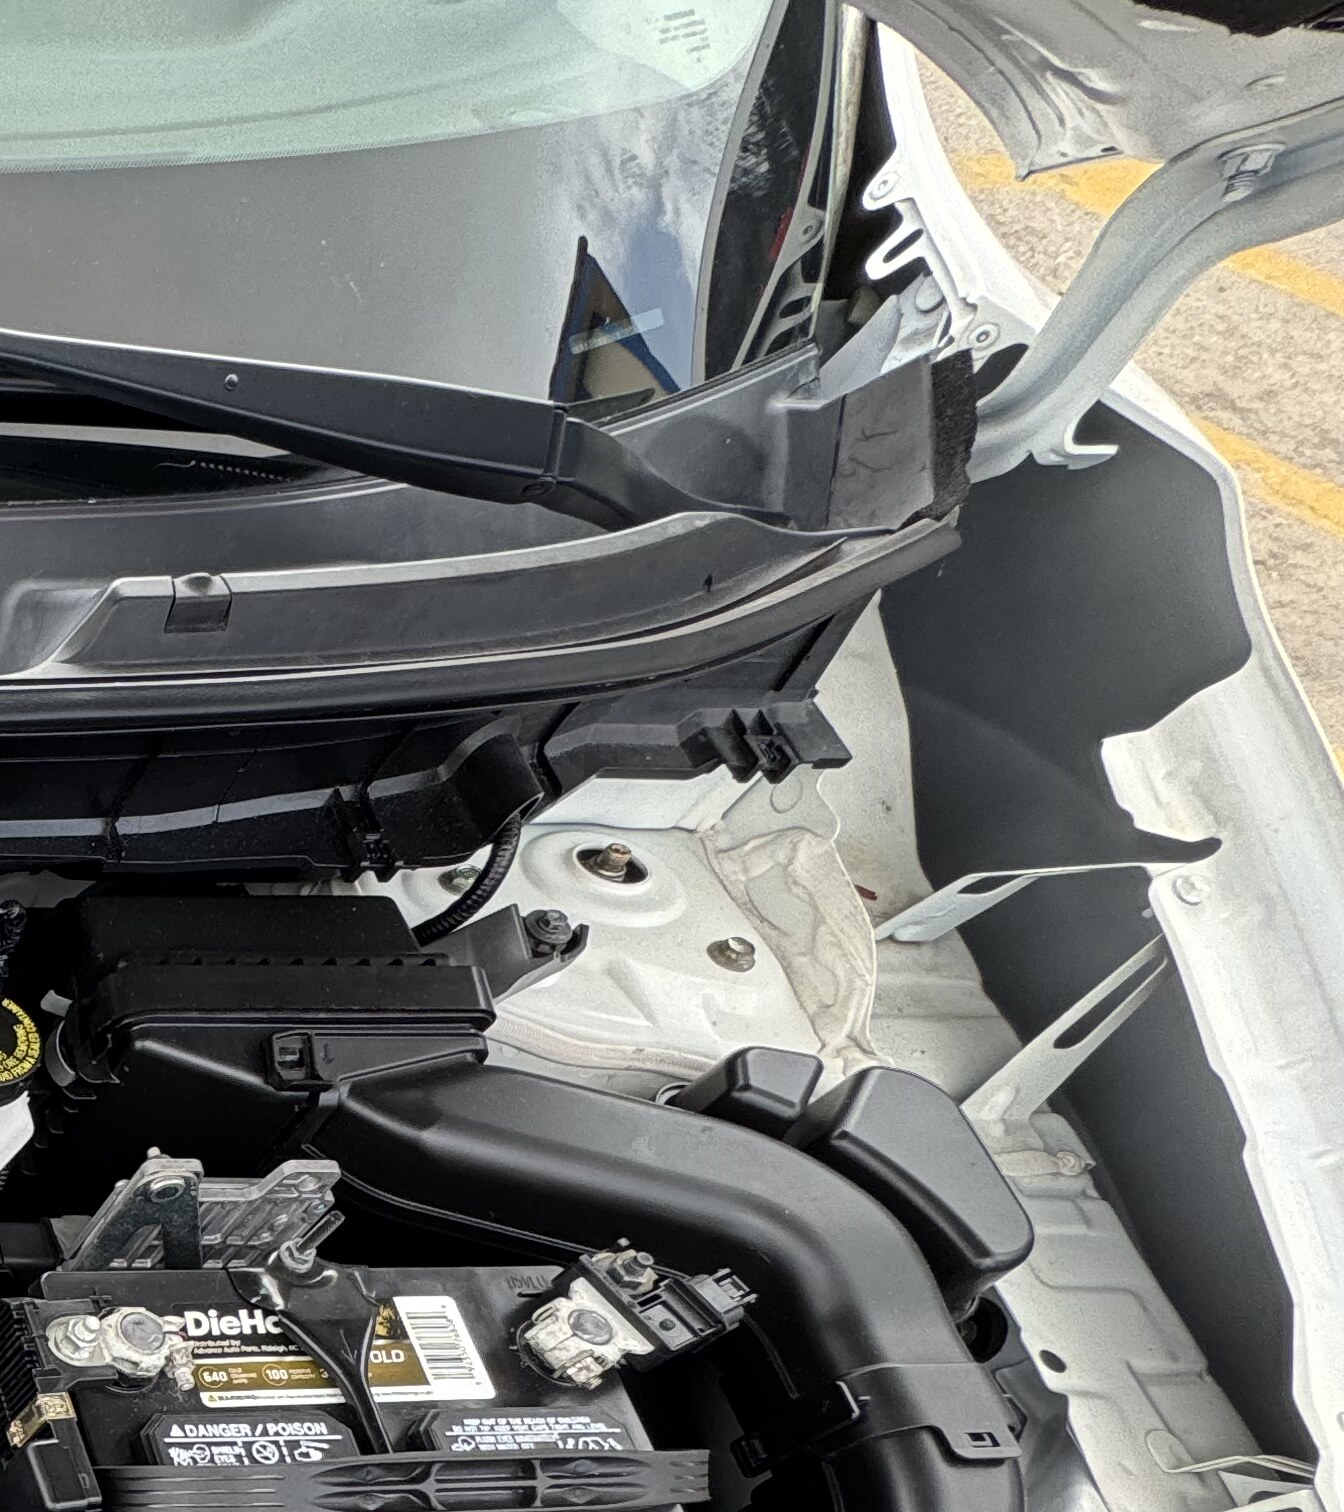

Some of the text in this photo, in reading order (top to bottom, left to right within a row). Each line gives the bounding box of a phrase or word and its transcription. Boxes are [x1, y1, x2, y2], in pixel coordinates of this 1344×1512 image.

[12, 1060, 33, 1078] FROM
[370, 1349, 405, 1363] OLD
[202, 1371, 228, 1383] 640
[265, 1369, 288, 1380] 100
[184, 1423, 251, 1437] DANGER
[266, 1422, 328, 1436] POISON
